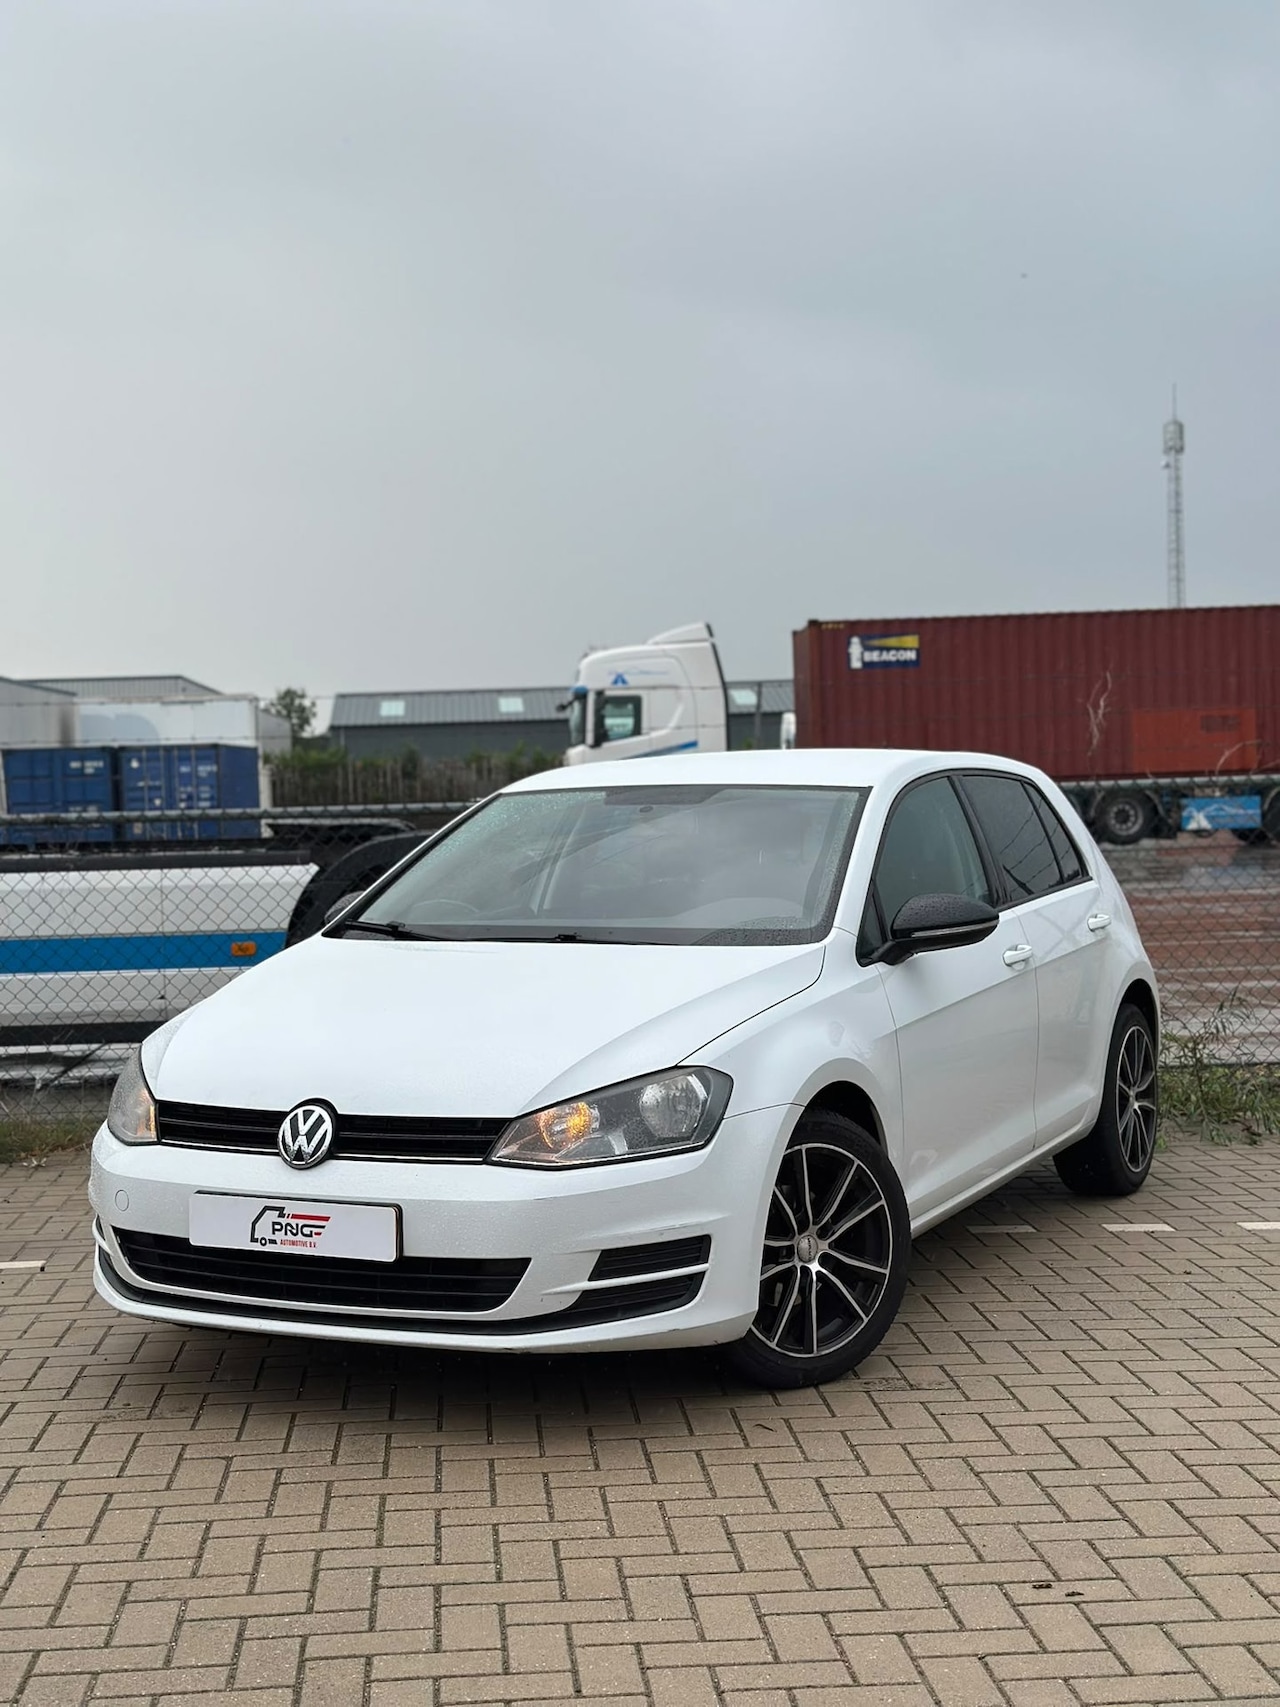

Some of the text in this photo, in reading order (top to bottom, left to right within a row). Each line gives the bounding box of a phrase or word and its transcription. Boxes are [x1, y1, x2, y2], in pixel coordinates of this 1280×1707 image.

[863, 649, 917, 662] BEACON
[280, 1107, 331, 1162] VW
[272, 1221, 326, 1238] PNG
[280, 1239, 308, 1248] AUTOMOTIVE
